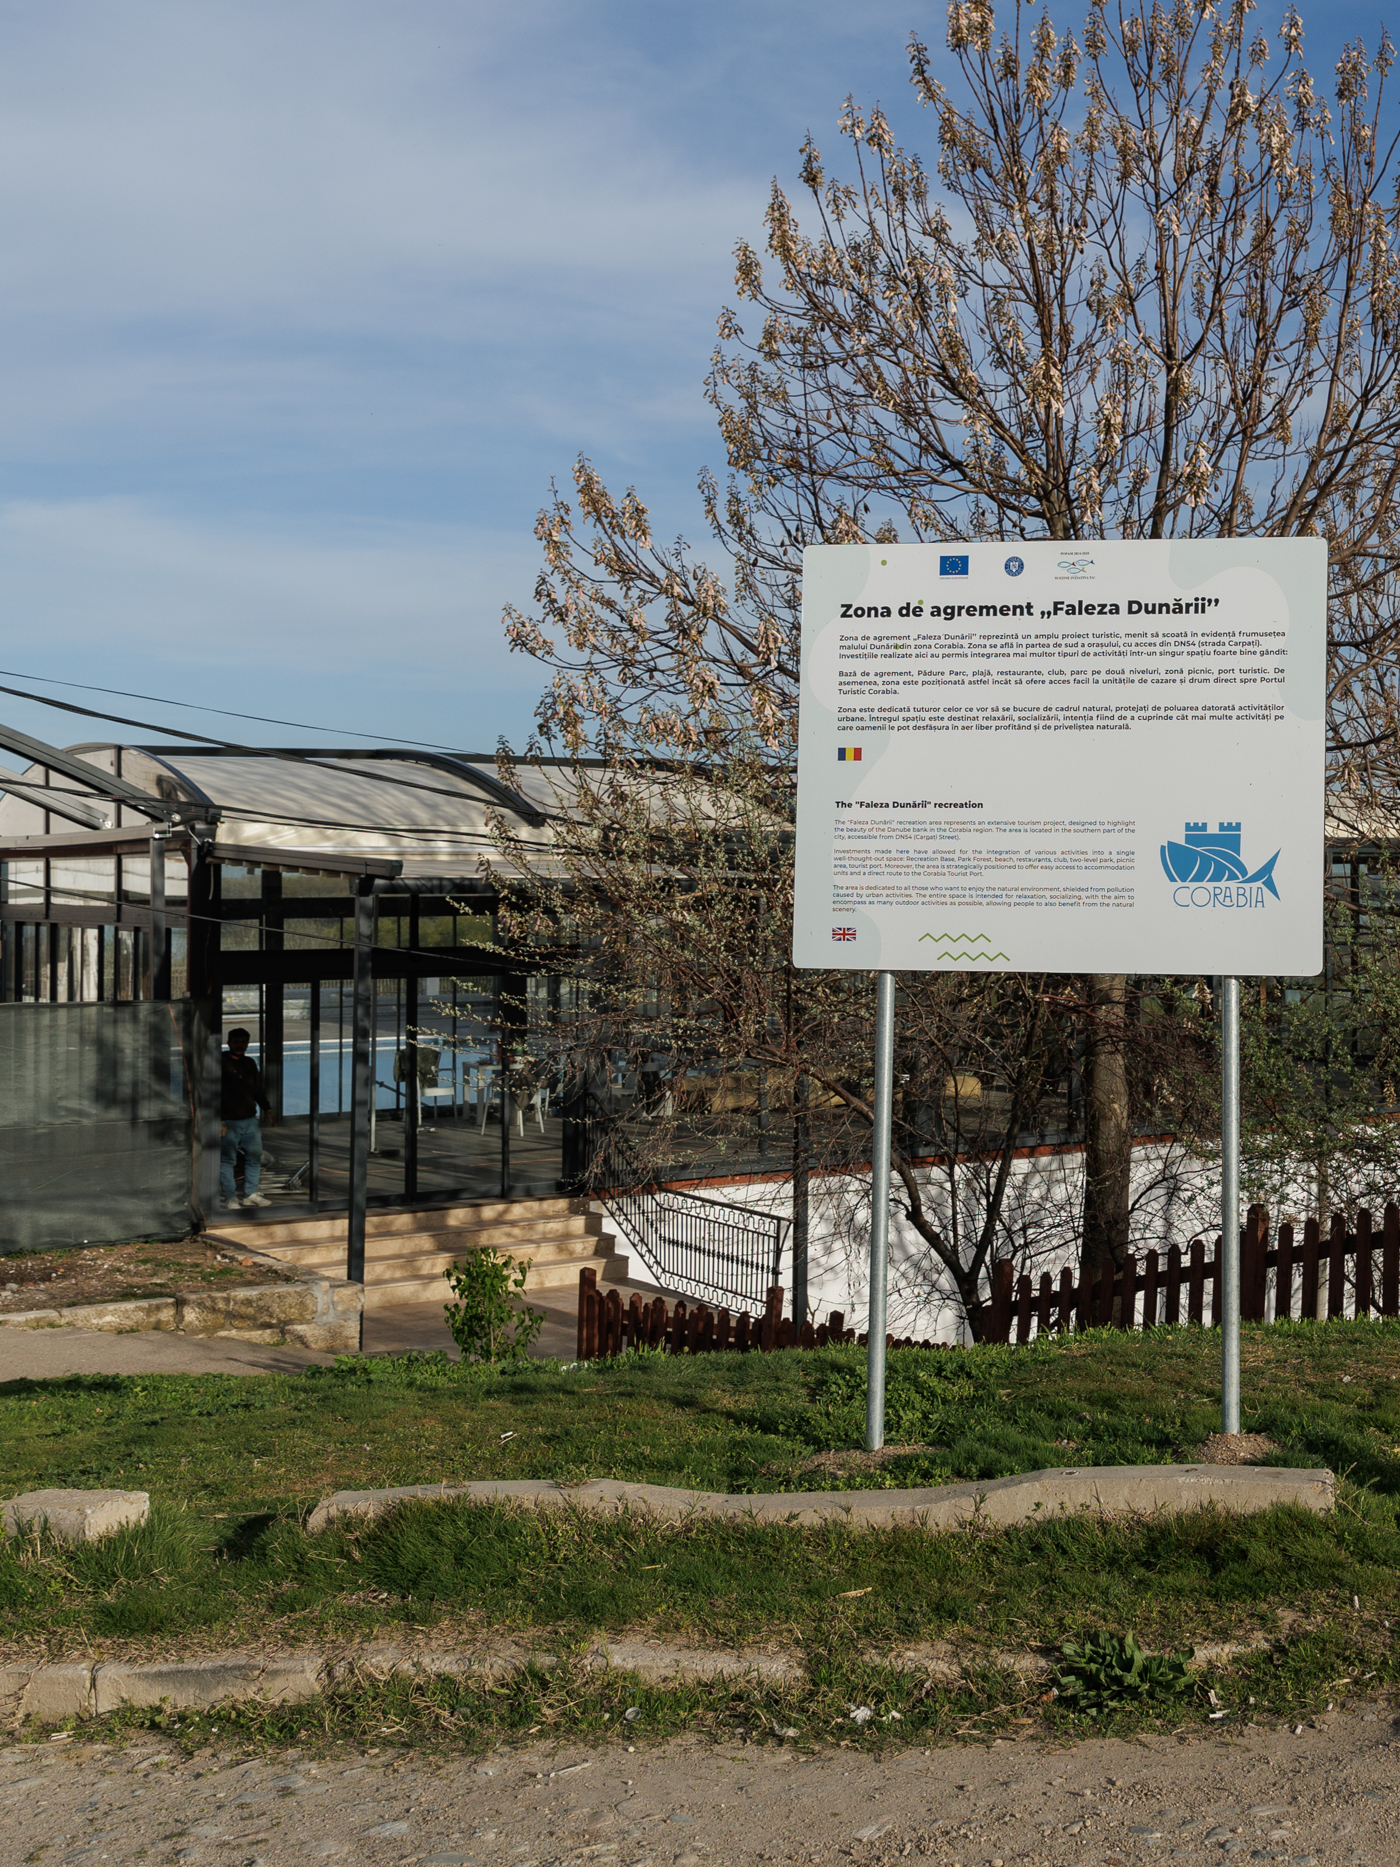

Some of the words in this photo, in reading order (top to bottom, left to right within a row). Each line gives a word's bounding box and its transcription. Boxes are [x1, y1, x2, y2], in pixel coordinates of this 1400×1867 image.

[840, 603, 892, 618] Zona
[898, 602, 924, 618] de
[930, 602, 1034, 621] agrement
[873, 634, 910, 642] agrement
[979, 632, 1019, 641] reprezintă
[1034, 632, 1059, 641] amplu
[1062, 632, 1089, 641] proiect
[1092, 632, 1122, 640] turistic,
[1201, 630, 1236, 639] evidență
[1239, 630, 1286, 639] frumusețea
[1026, 642, 1050, 650] partea
[1087, 641, 1121, 650] orașului,
[1198, 640, 1226, 649] (strada
[1228, 640, 1262, 648] Carpați).
[839, 652, 878, 660] Investițiile
[942, 651, 968, 660] permis
[971, 651, 1010, 660] integrarea
[1058, 650, 1079, 659] tipuri
[1093, 650, 1127, 659] activități
[1159, 649, 1184, 658] singur
[1186, 649, 1211, 658] spațiu
[874, 670, 914, 678] agrement,
[949, 669, 968, 677] Parc,
[973, 669, 993, 678] plajă,
[1048, 668, 1066, 676] club,
[1130, 668, 1161, 676] niveluri,
[1188, 668, 1214, 676] picnic,
[1218, 668, 1235, 676] port
[921, 678, 966, 687] poziționată
[1102, 677, 1136, 686] unitățile
[1179, 677, 1186, 686] și
[934, 800, 983, 808] recreation
[1173, 886, 1265, 908] CORABIA
